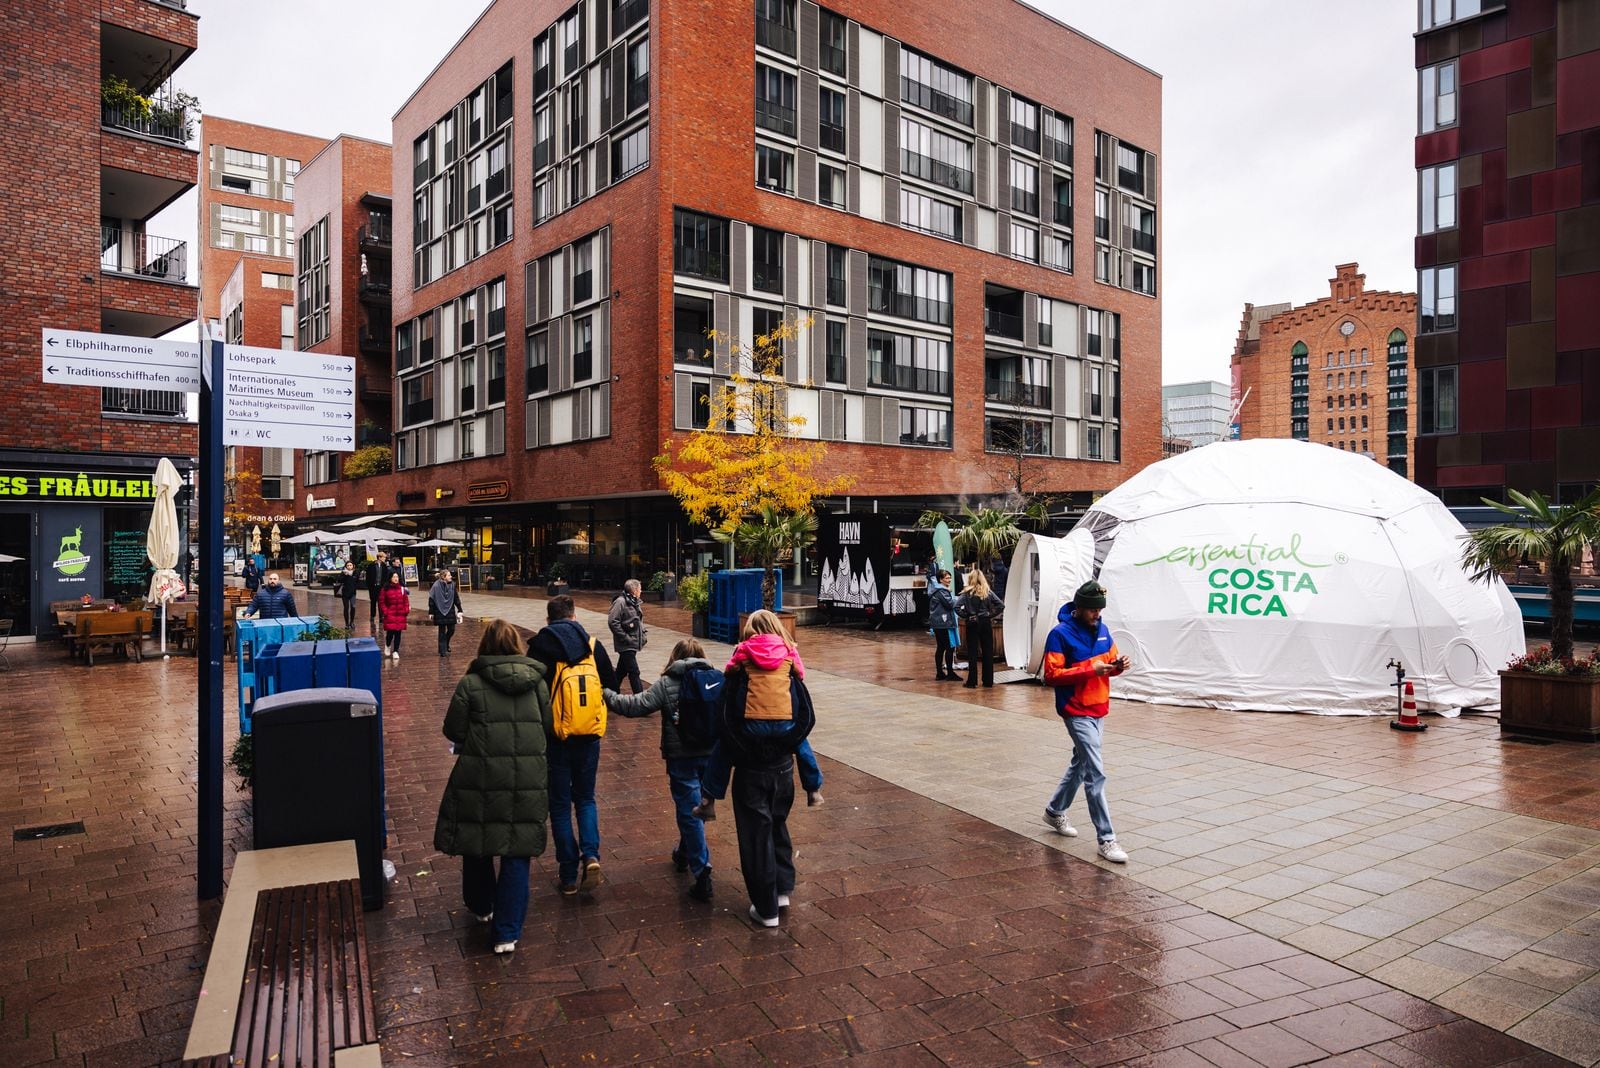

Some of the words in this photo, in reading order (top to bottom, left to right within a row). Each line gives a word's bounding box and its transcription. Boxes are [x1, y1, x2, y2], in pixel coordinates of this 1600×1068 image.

[66, 338, 153, 355] Elbphilharmonie
[175, 350, 189, 358] 900
[229, 353, 276, 366] Lohsepark
[66, 366, 170, 382] Traditionsschiffhafen
[229, 374, 296, 387] Internationales
[229, 385, 274, 396] Maritimes
[277, 388, 313, 398] Museum
[229, 399, 315, 412] Nachhaltigkeitspavillon
[229, 409, 251, 418] Osaka
[256, 430, 272, 439] WC
[839, 522, 860, 539] HAVN
[1134, 532, 1332, 570] essential
[1208, 568, 1318, 594] COSTA
[1207, 593, 1288, 617] RICA
